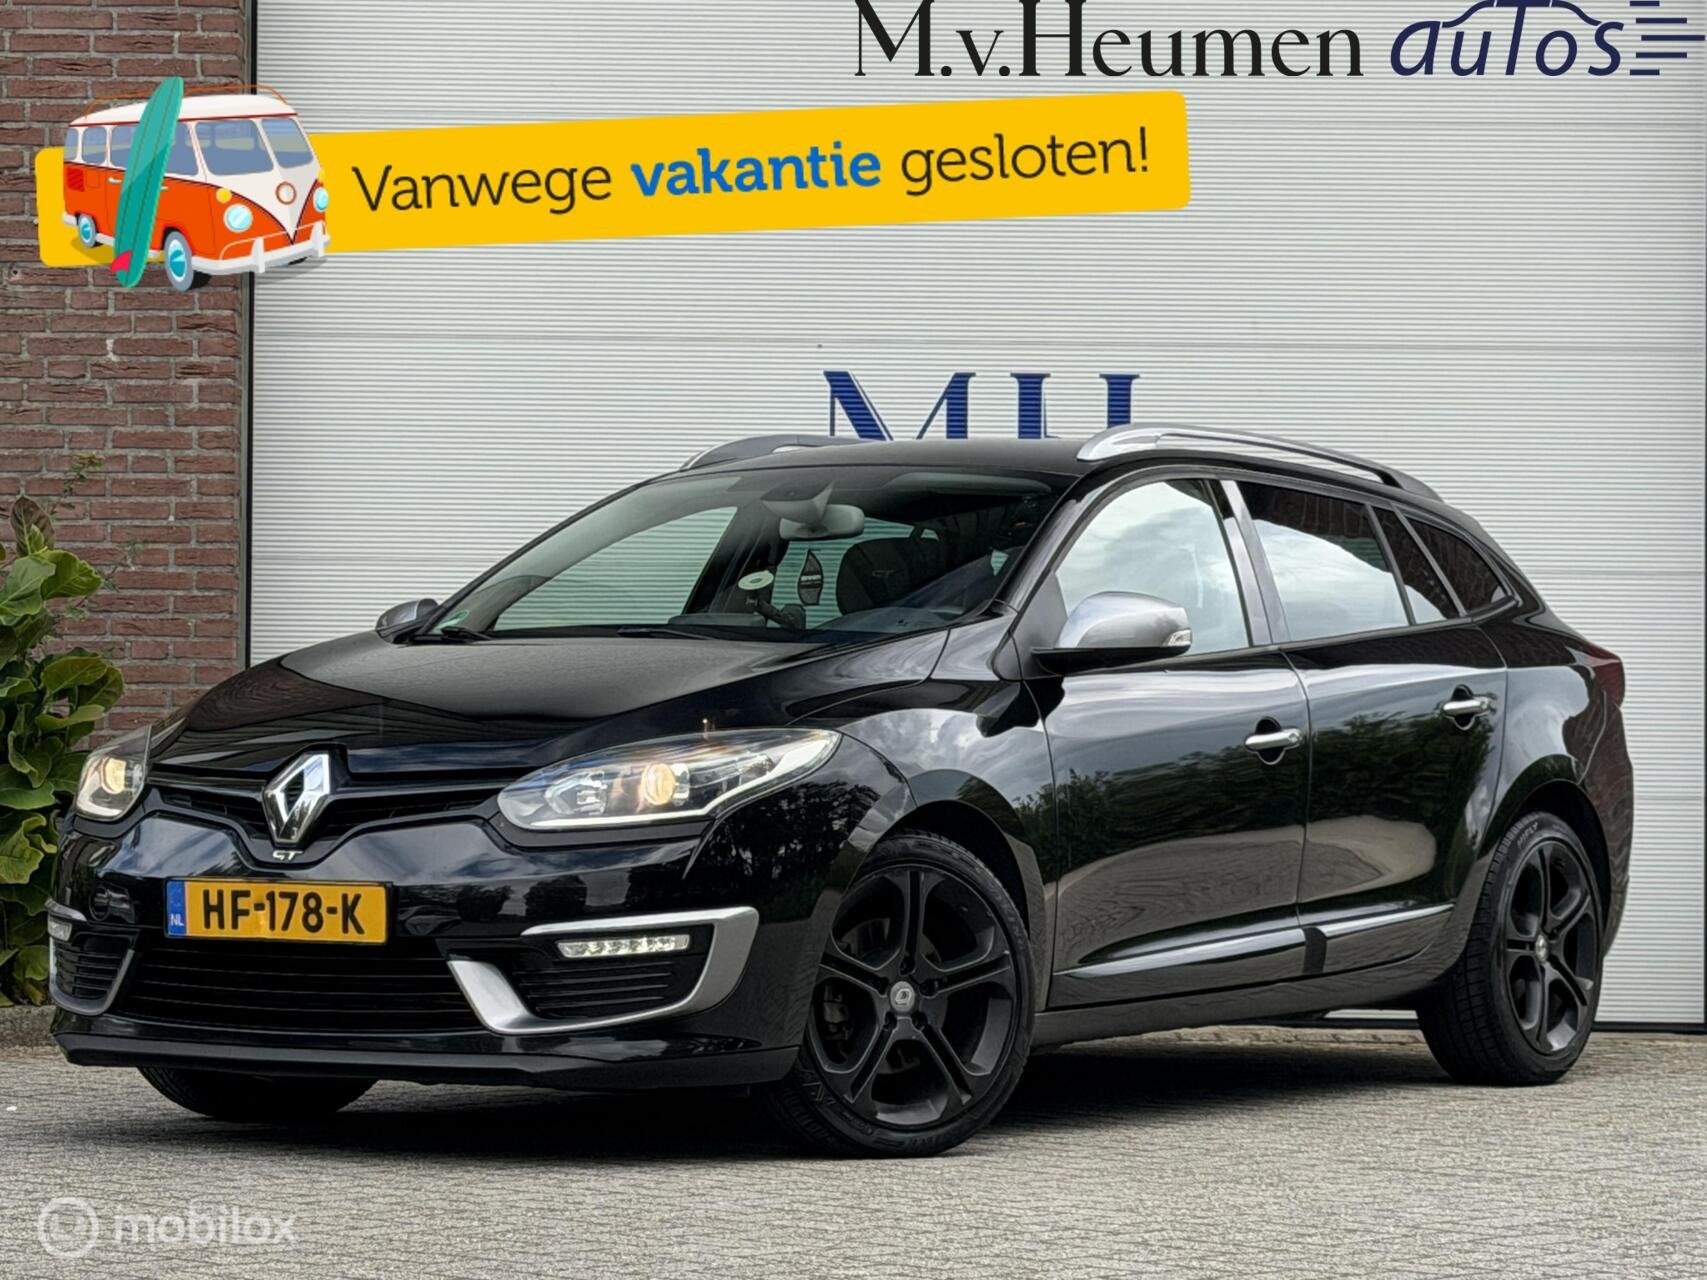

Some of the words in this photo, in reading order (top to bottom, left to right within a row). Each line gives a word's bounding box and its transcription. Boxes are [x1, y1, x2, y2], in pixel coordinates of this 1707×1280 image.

[272, 850, 303, 861] GT
[170, 914, 184, 927] NL
[202, 889, 365, 935] HF-178-K
